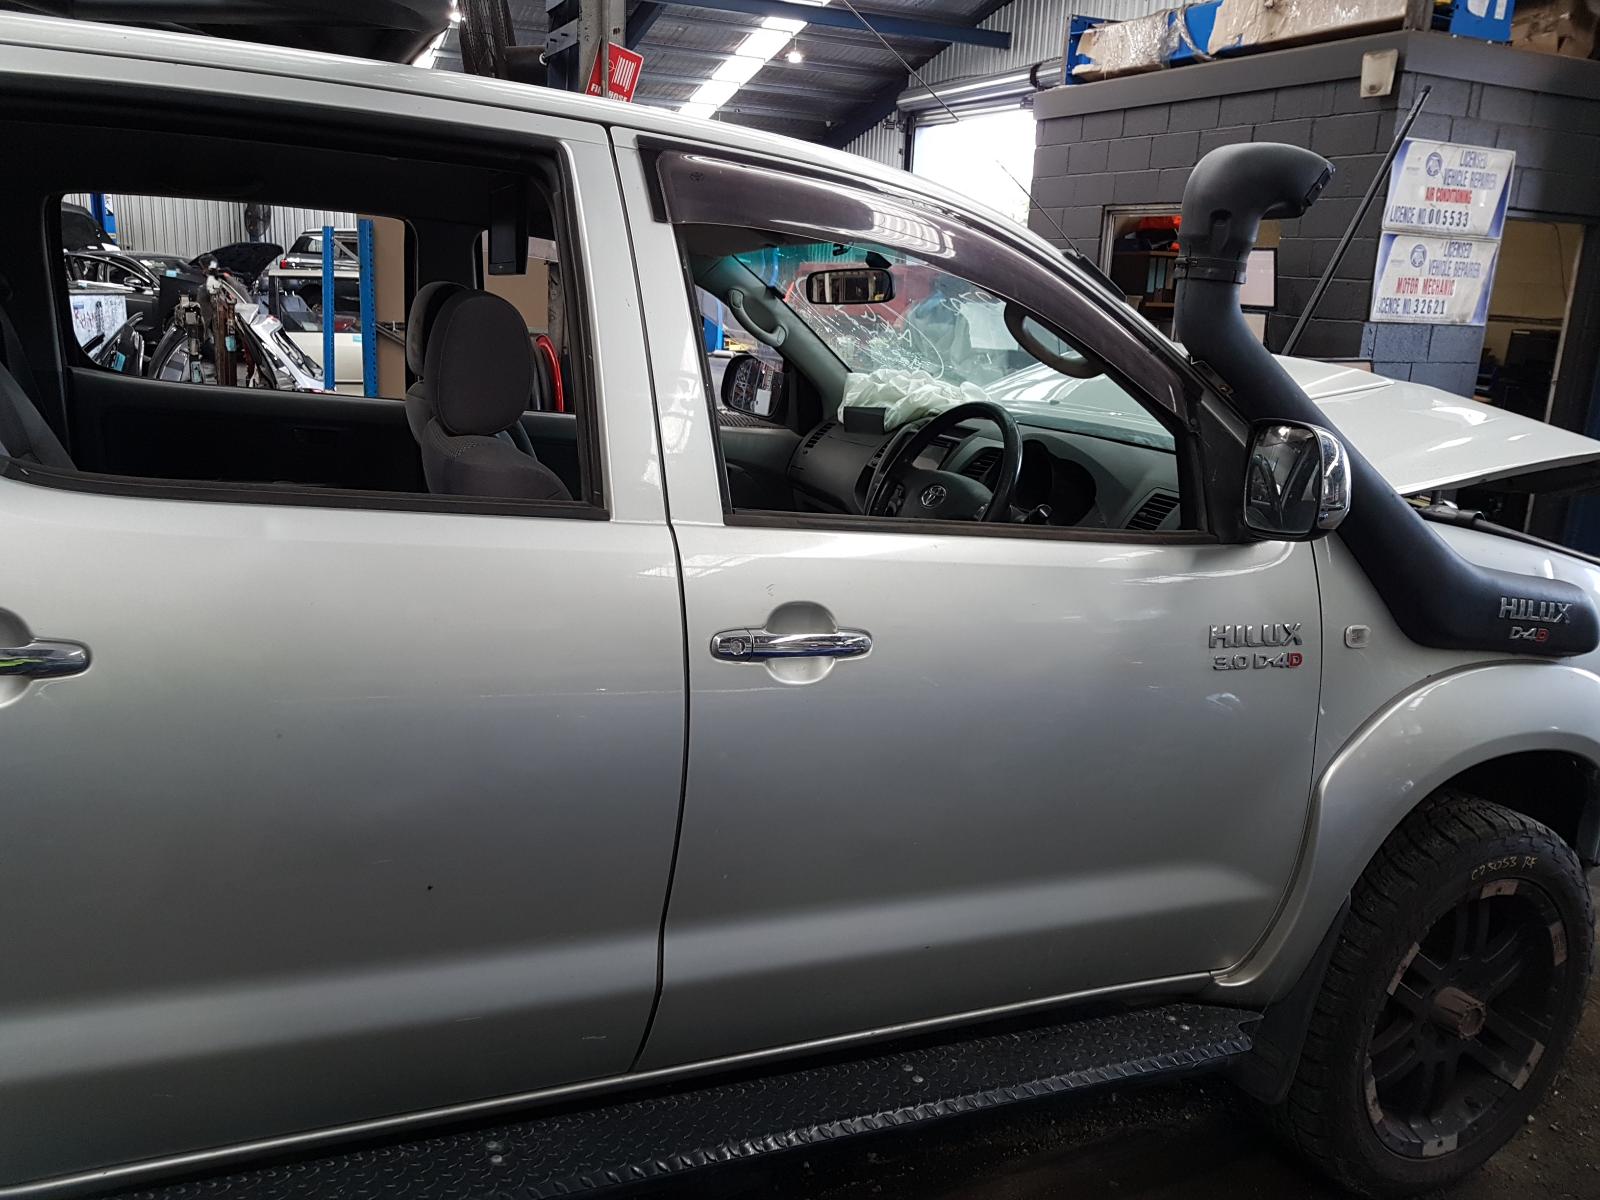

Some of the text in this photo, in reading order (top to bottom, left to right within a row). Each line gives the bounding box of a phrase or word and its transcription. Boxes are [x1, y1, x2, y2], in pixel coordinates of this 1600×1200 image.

[1443, 168, 1468, 187] VEHICLE
[1425, 187, 1472, 204] AIR CONDITIONING
[1390, 204, 1416, 224] LICENCE
[1428, 208, 1470, 228] 005533
[1443, 241, 1472, 259] LICENSED
[1428, 259, 1481, 279] VEHICLE REPAIRER
[1396, 277, 1455, 296] MOTOR MECHANIC
[1413, 299, 1446, 315] 32621
[1499, 596, 1572, 624] HILUX
[1208, 622, 1303, 648] HILUX
